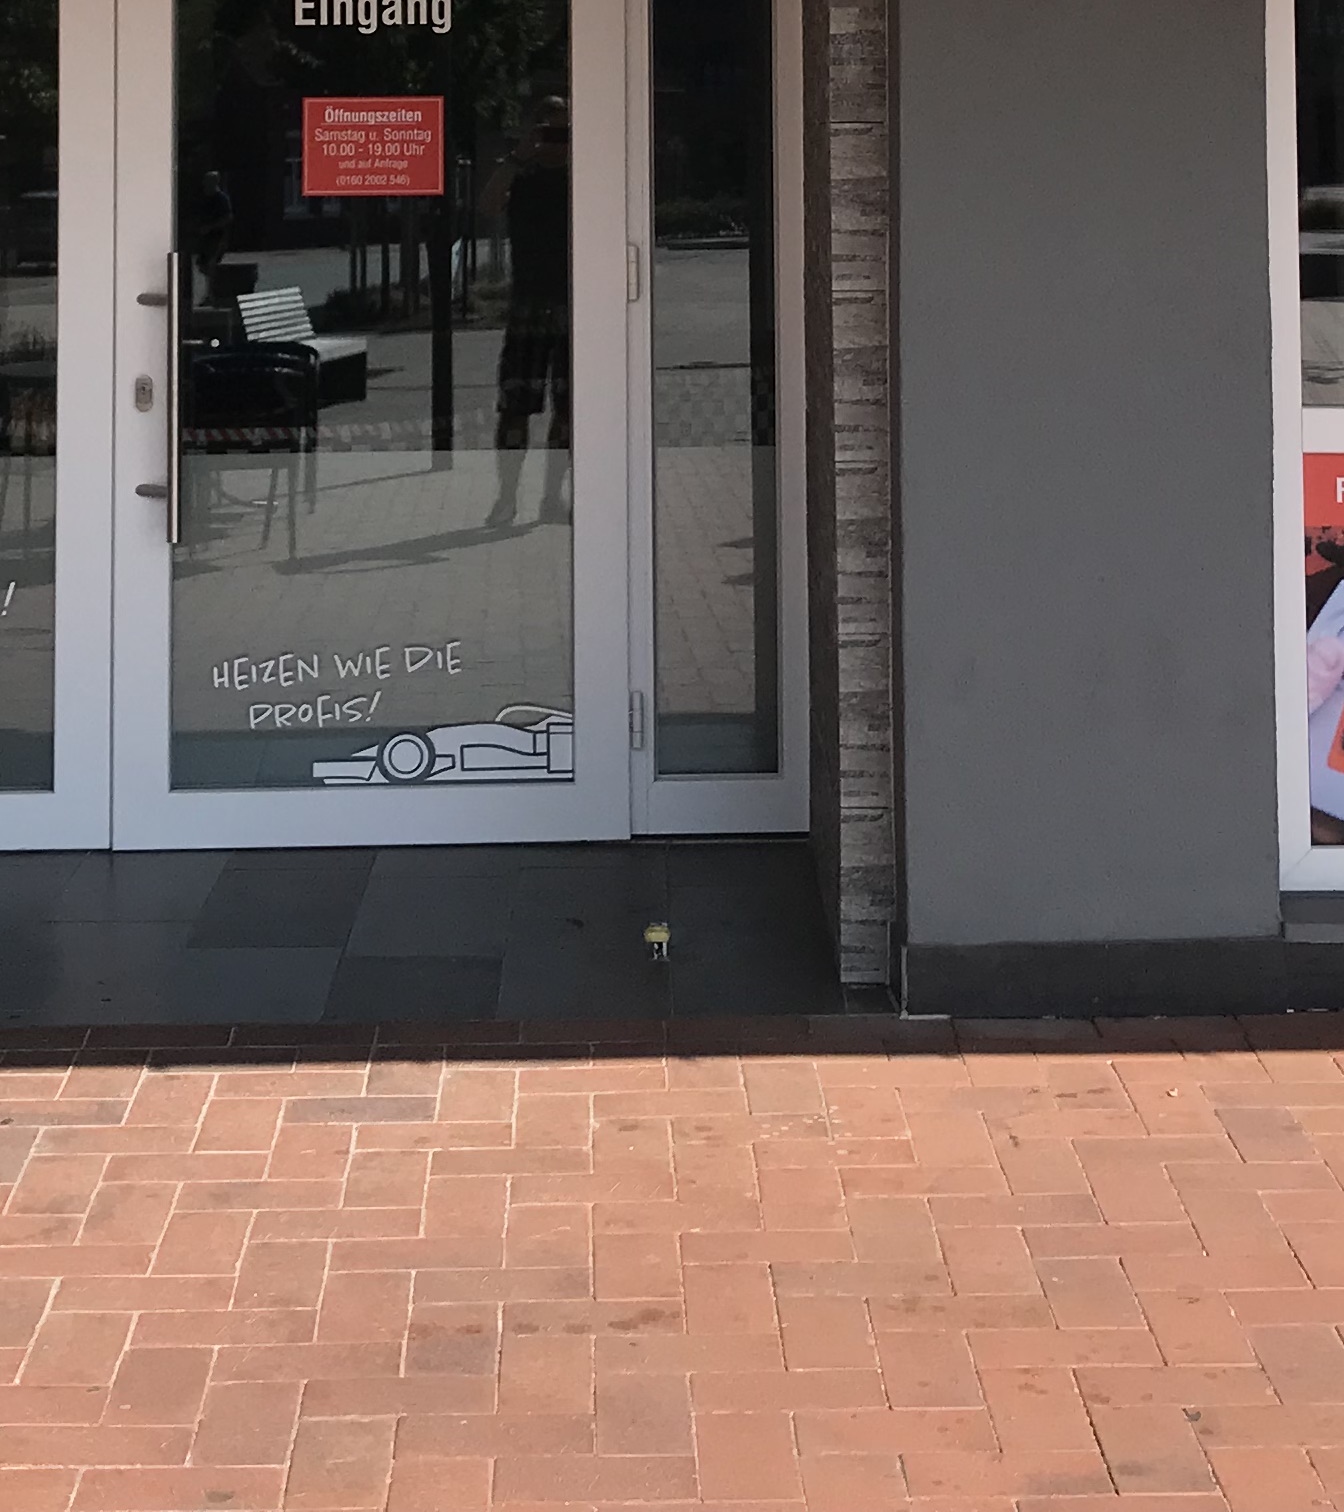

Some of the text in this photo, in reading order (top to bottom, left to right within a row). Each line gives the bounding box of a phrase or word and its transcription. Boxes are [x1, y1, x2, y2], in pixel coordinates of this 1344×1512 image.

[325, 106, 422, 124] Öffnungszeiten
[314, 128, 432, 143] Samstag u. Sonntag
[322, 143, 355, 156] 10.00
[368, 143, 400, 156] 19.00
[403, 143, 425, 155] Uhr
[338, 159, 408, 170] und auf Anfrage
[213, 641, 462, 690] HEIZEN WIE DIE
[249, 691, 382, 729] PROFIS!
